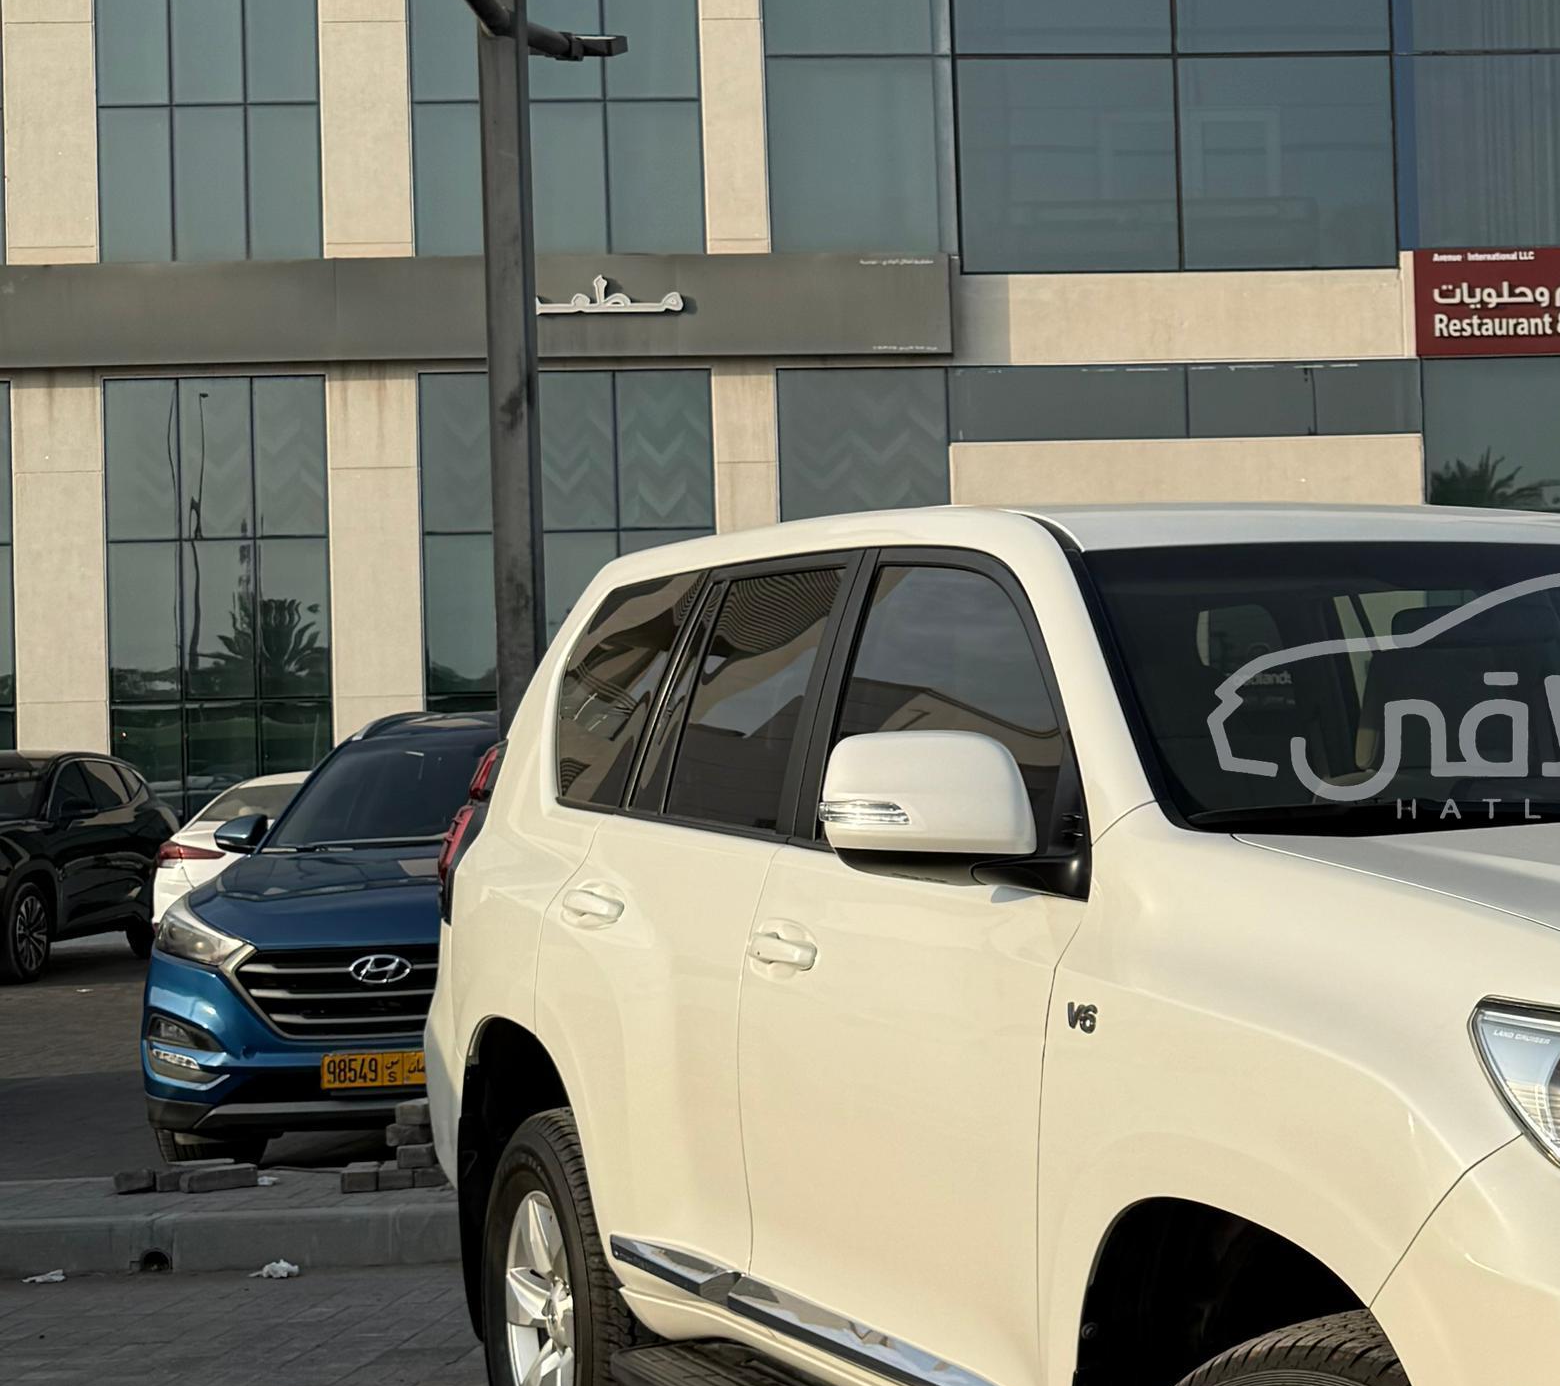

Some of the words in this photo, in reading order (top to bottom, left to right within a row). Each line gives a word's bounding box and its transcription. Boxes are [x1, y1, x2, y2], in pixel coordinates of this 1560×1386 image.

[1466, 251, 1518, 262] International
[1518, 250, 1535, 261] LLC
[535, 274, 684, 316] مطع
[1432, 281, 1550, 309] وحلويات
[1434, 313, 1553, 338] Restaurant
[1067, 1001, 1098, 1034] V6
[327, 1057, 378, 1083] 98549
